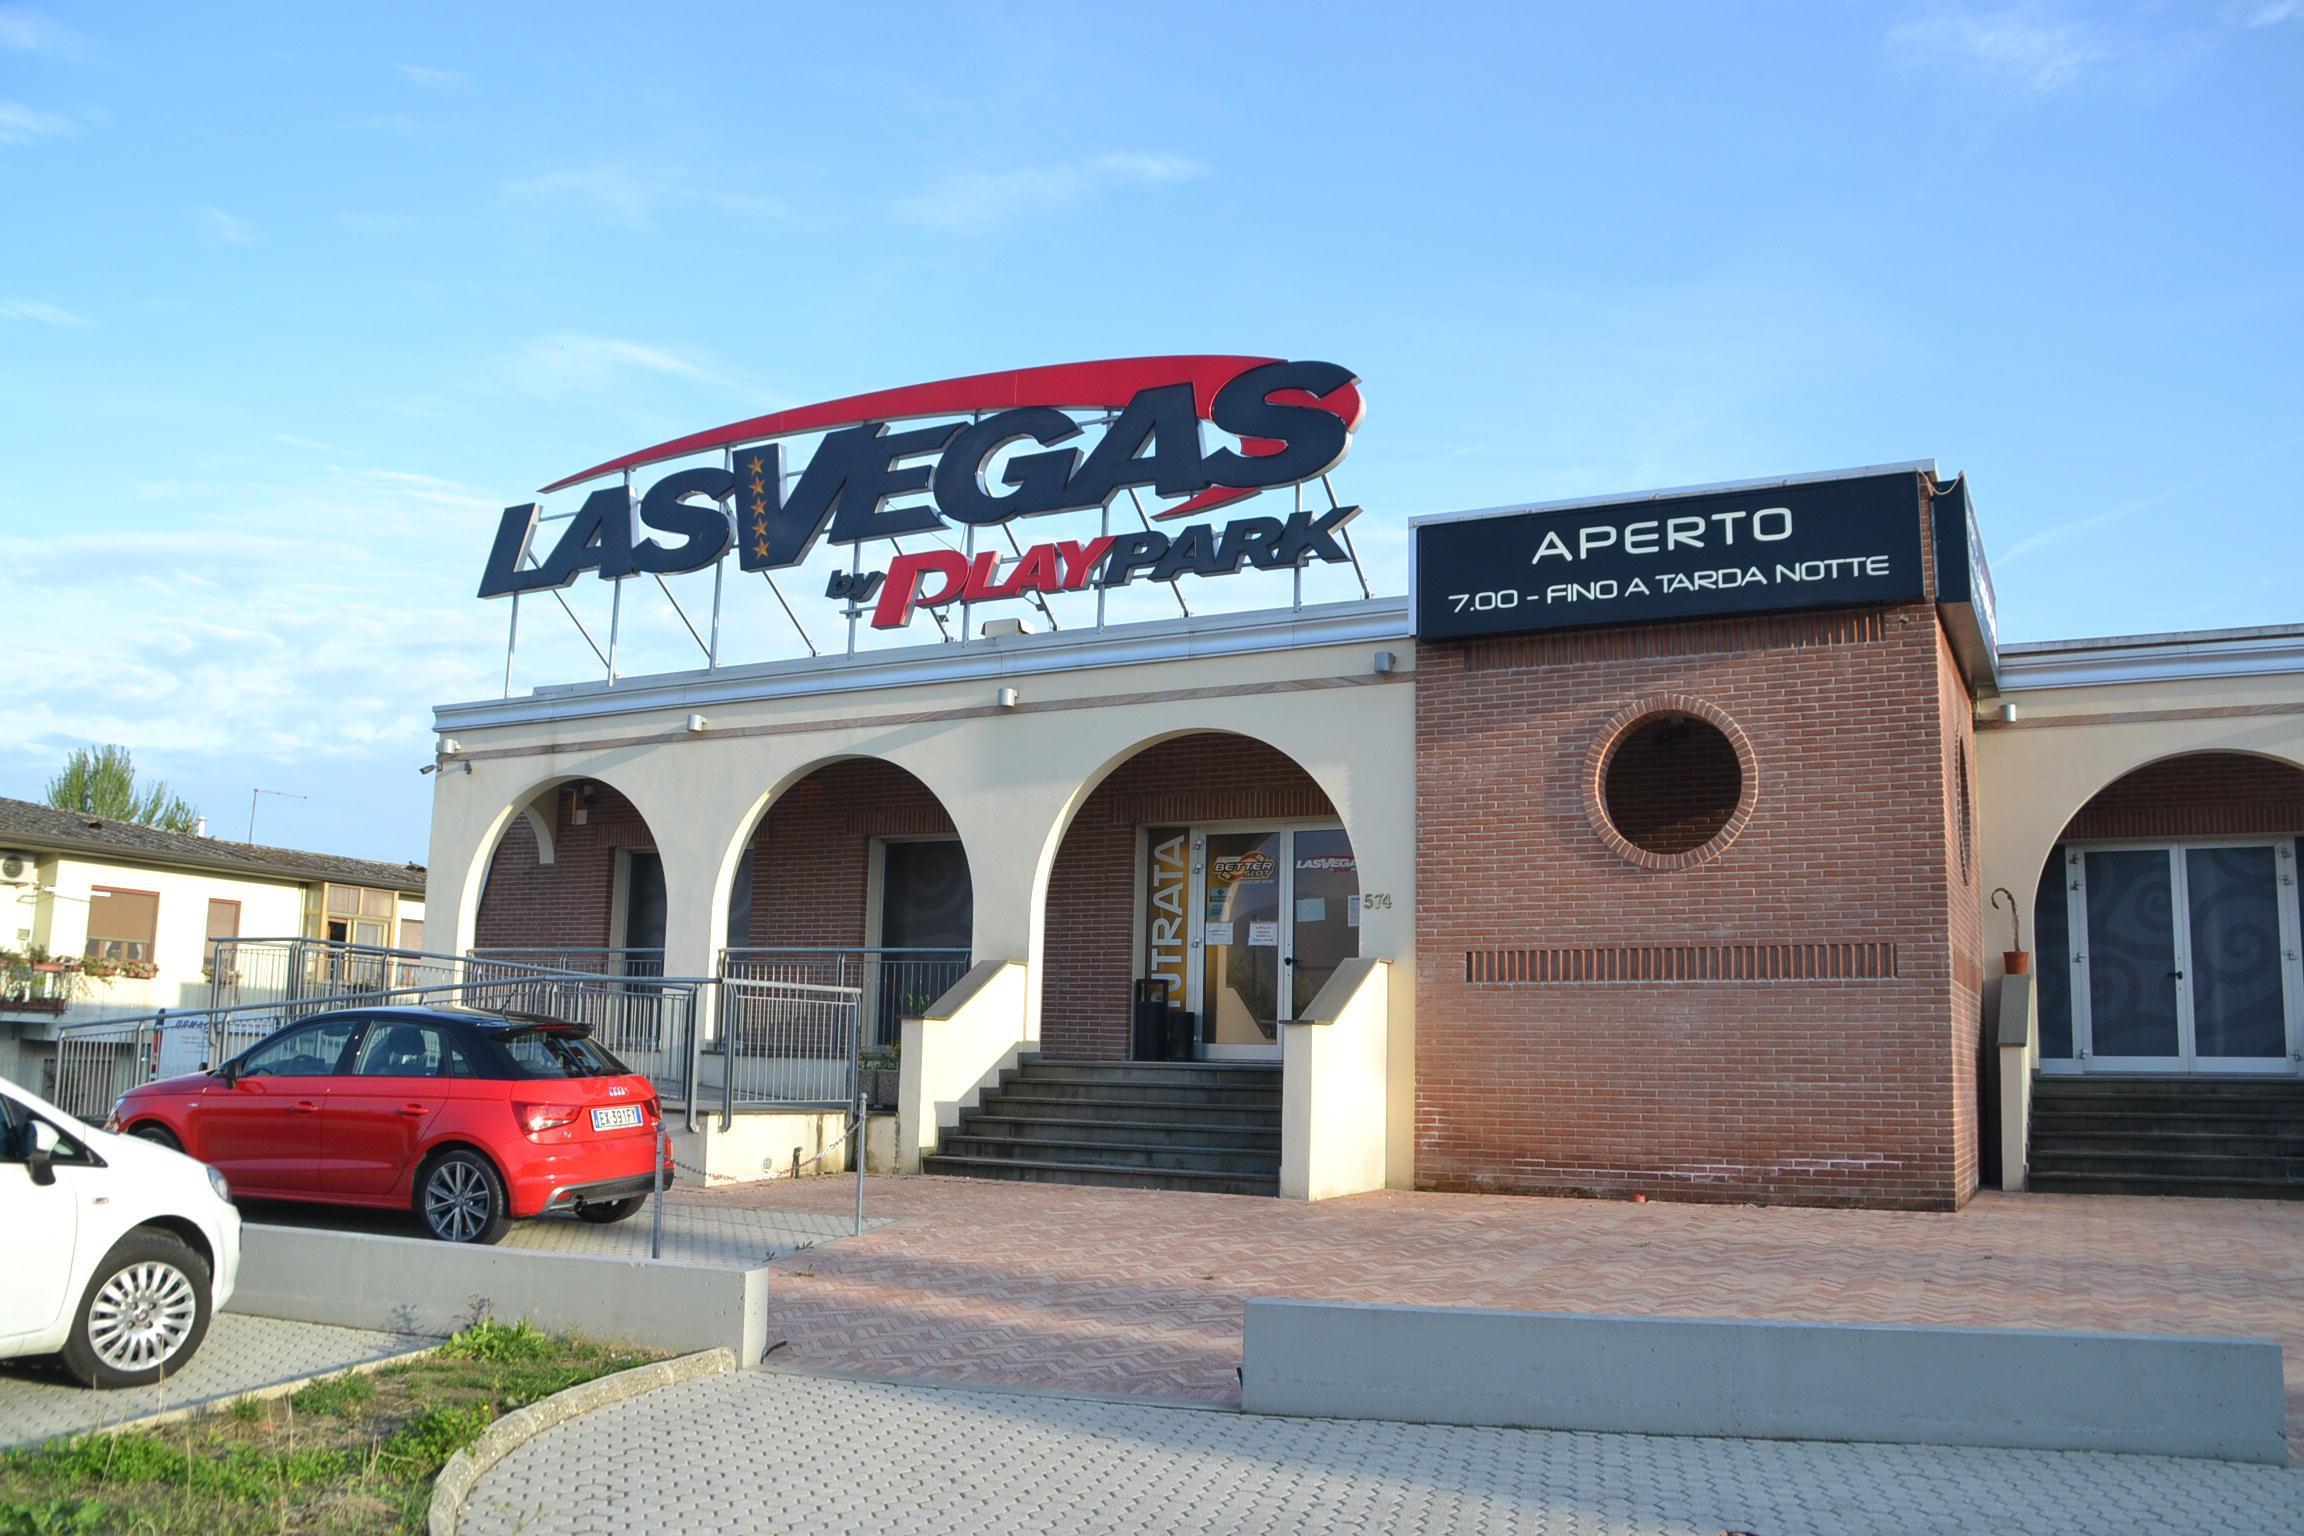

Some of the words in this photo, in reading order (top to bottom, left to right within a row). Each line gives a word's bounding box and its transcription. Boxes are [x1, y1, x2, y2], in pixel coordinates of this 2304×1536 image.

[1531, 507, 1793, 565] APERTO
[825, 569, 886, 601] by
[1448, 589, 1518, 613] 7.00
[1547, 579, 1617, 604] FINO
[1624, 576, 1651, 597] A
[1655, 566, 1768, 594] TARDA
[1776, 555, 1890, 584] NOTTE
[1214, 861, 1272, 872] BETTER
[1150, 834, 1185, 1008] NTRATA
[1363, 894, 1392, 910] 574
